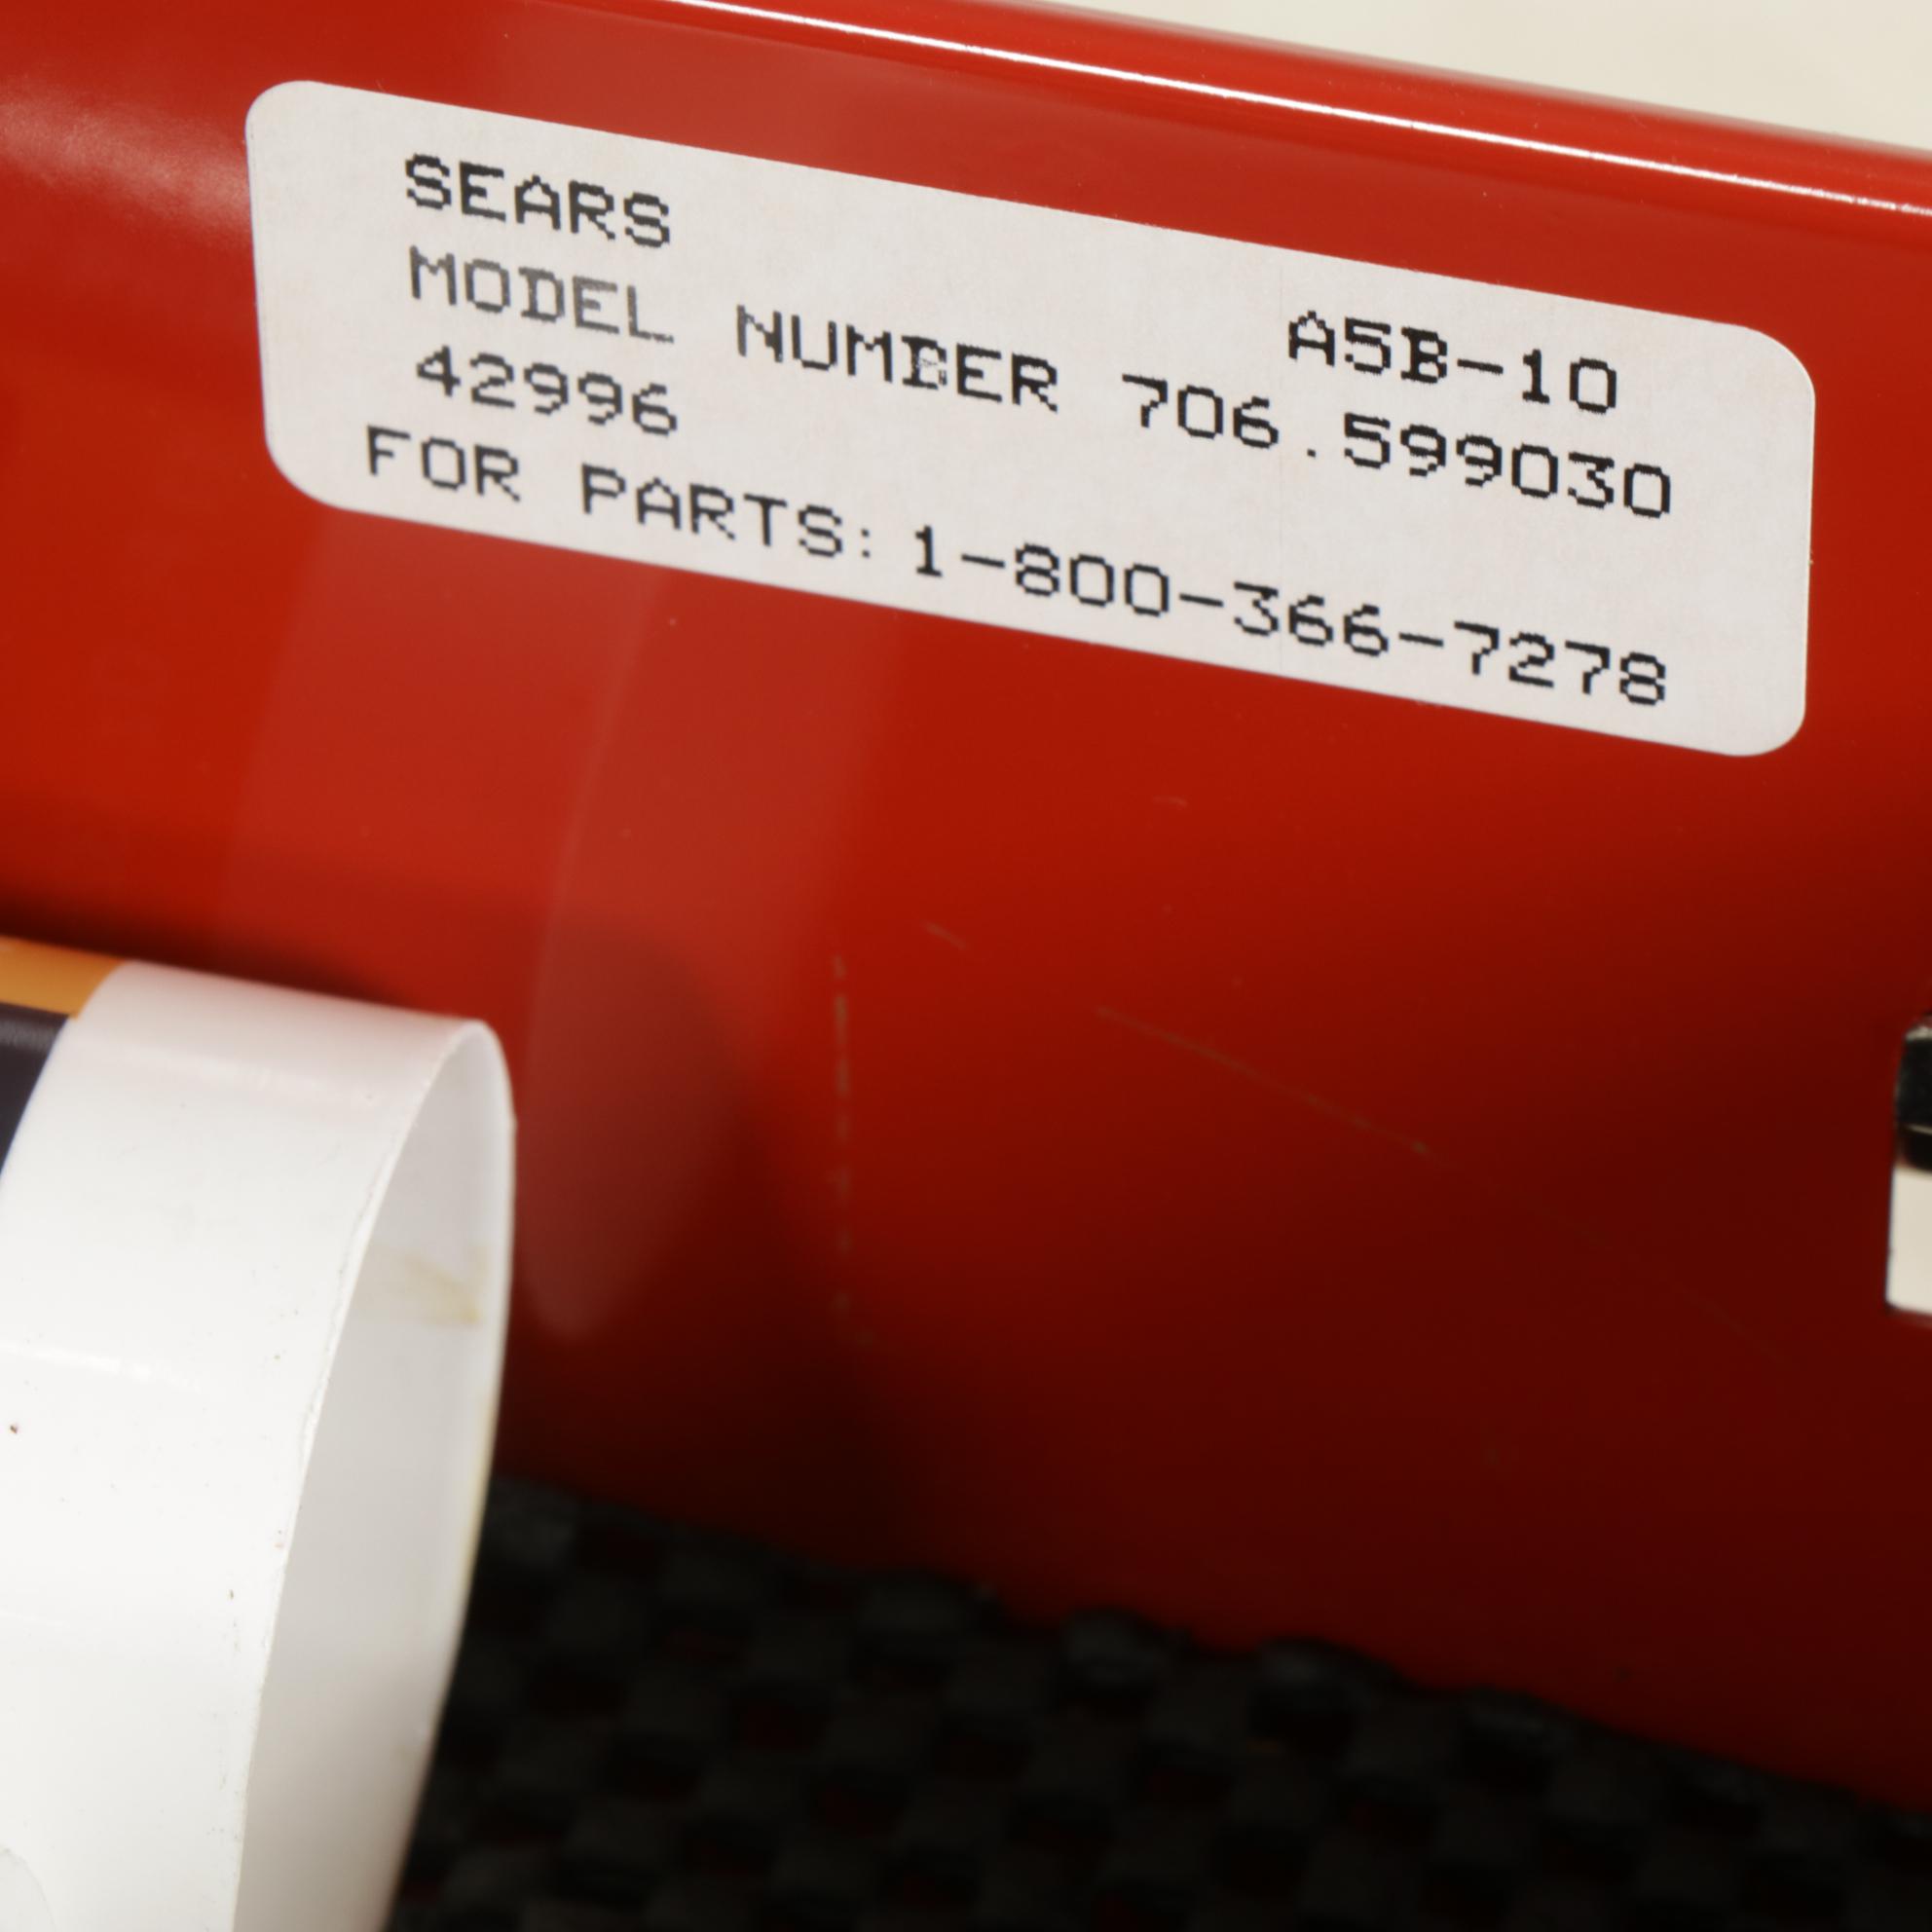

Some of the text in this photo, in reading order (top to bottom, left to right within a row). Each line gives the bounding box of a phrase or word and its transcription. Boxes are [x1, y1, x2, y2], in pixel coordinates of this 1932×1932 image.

[404, 153, 1617, 416] SEARS A5B-10
[409, 245, 1672, 519] MODEL NUMBER 706.599030
[416, 345, 678, 436] 42996
[367, 425, 1666, 707] FOR PARTS: 1-800-366-7278
